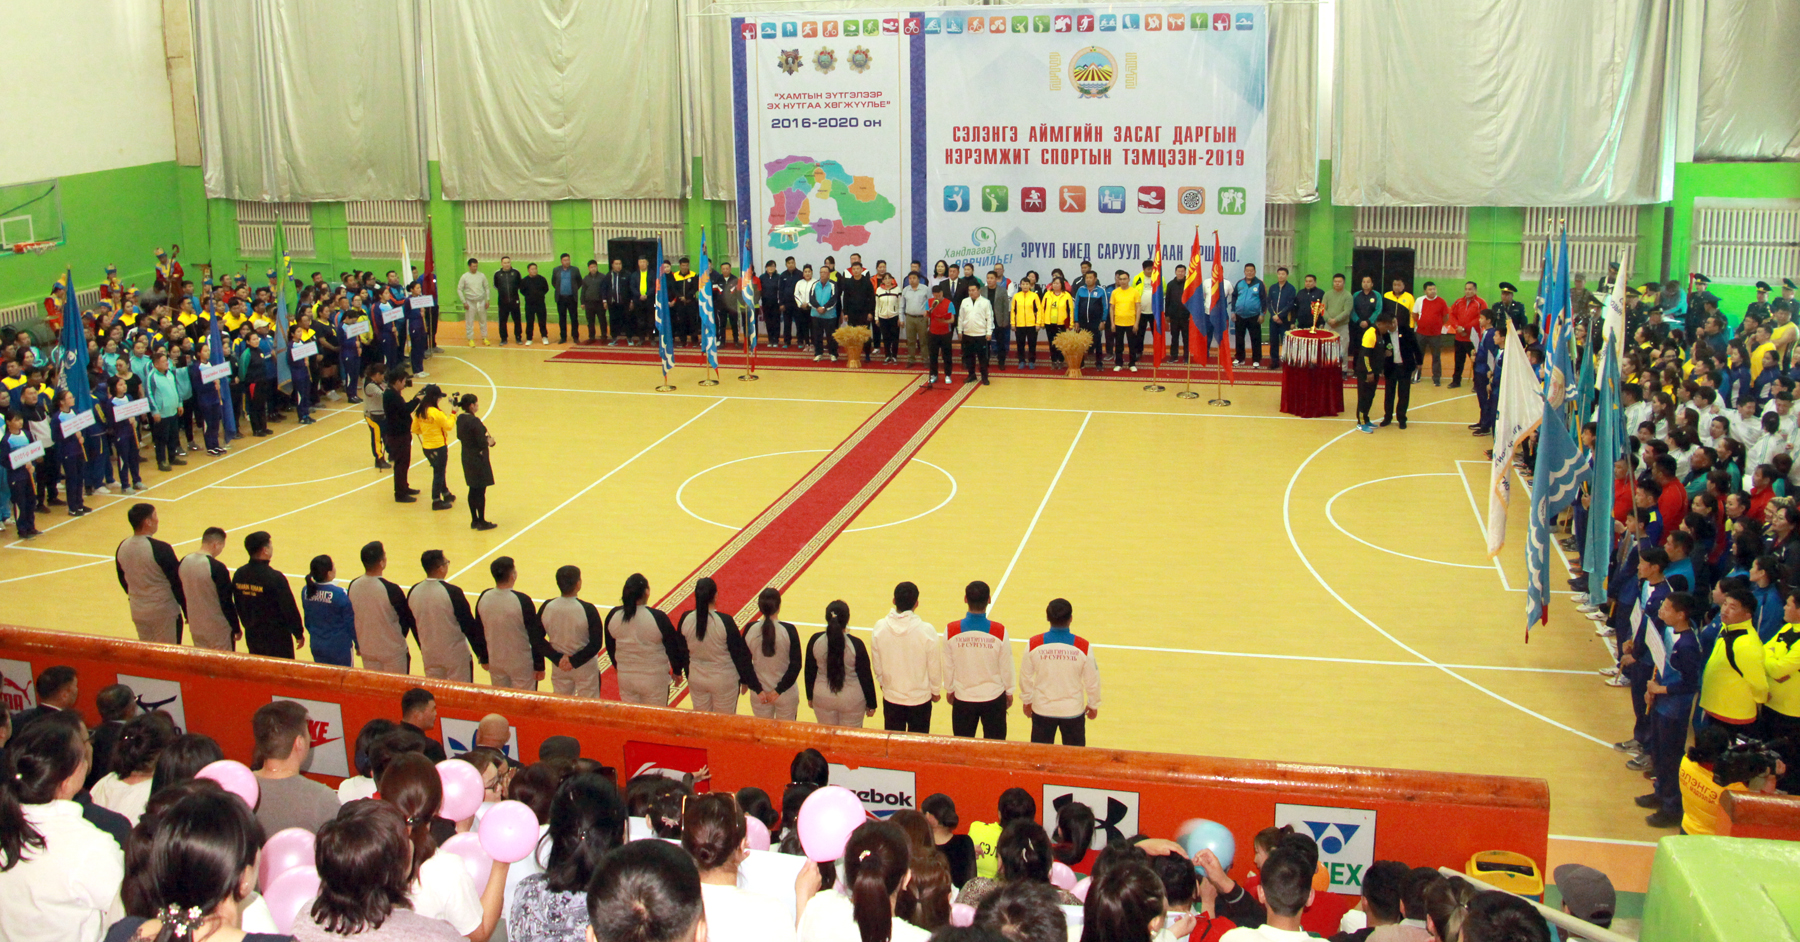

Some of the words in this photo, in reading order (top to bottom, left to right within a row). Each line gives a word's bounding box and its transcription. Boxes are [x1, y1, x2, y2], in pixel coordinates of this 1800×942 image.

[825, 91, 882, 100] ЗҮТГЭЛЭЭР
[771, 117, 859, 129] 2016-2020
[863, 119, 882, 127] он
[953, 126, 1018, 142] СЭЛЭНГЭ
[1029, 123, 1103, 142] АЙМГИЙН
[1113, 126, 1162, 142] ЗАСАГ
[1173, 126, 1236, 145] ДАРГЫН
[945, 148, 1030, 164] НЭРЭМЖИТ
[1041, 149, 1112, 165] СПОРТЫН
[1123, 149, 1244, 168] ТЭМЦЭЭН-2019
[944, 246, 992, 259] Хандлагаа
[1021, 242, 1055, 258] ЭРҮҮЛ
[1063, 243, 1091, 261] БИЕД
[1097, 243, 1140, 260] САРУУЛ
[1147, 244, 1183, 261] УААН
[306, 719, 330, 740] KE
[1680, 769, 1718, 800] ЭЛЭНГЭ
[853, 788, 912, 807] ebok
